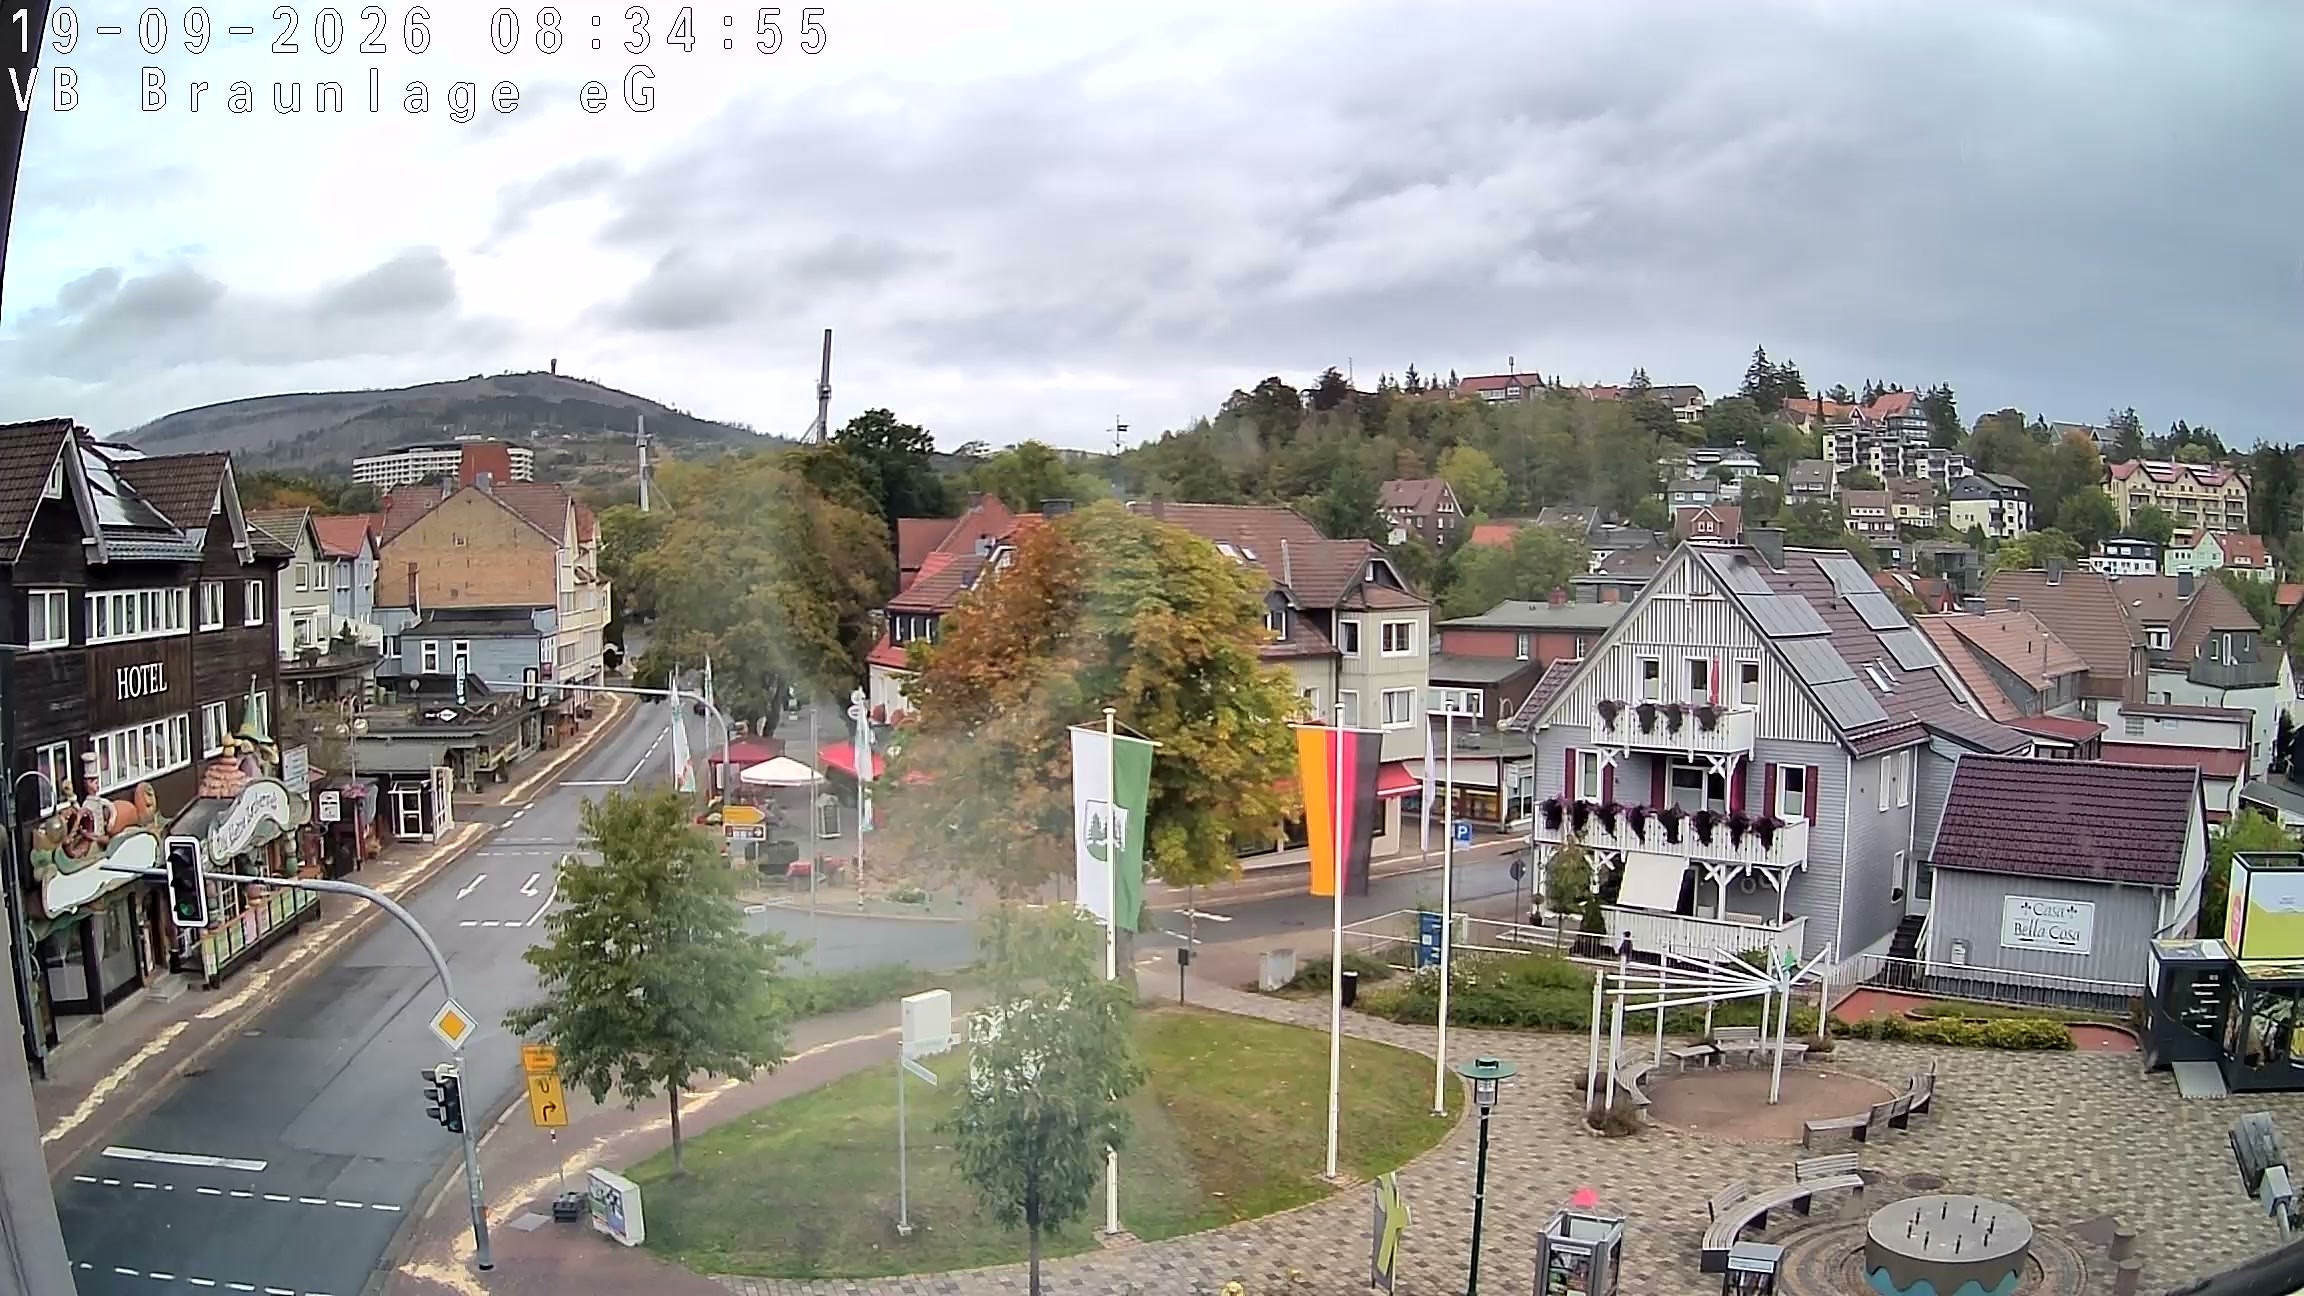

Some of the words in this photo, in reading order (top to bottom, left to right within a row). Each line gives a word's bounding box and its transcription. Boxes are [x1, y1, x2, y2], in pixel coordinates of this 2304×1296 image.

[116, 661, 168, 701] HOTEL
[1457, 825, 1468, 840] P
[2032, 902, 2065, 918] Casa
[2013, 918, 2046, 938] Bella
[2048, 925, 2080, 941] Casa
